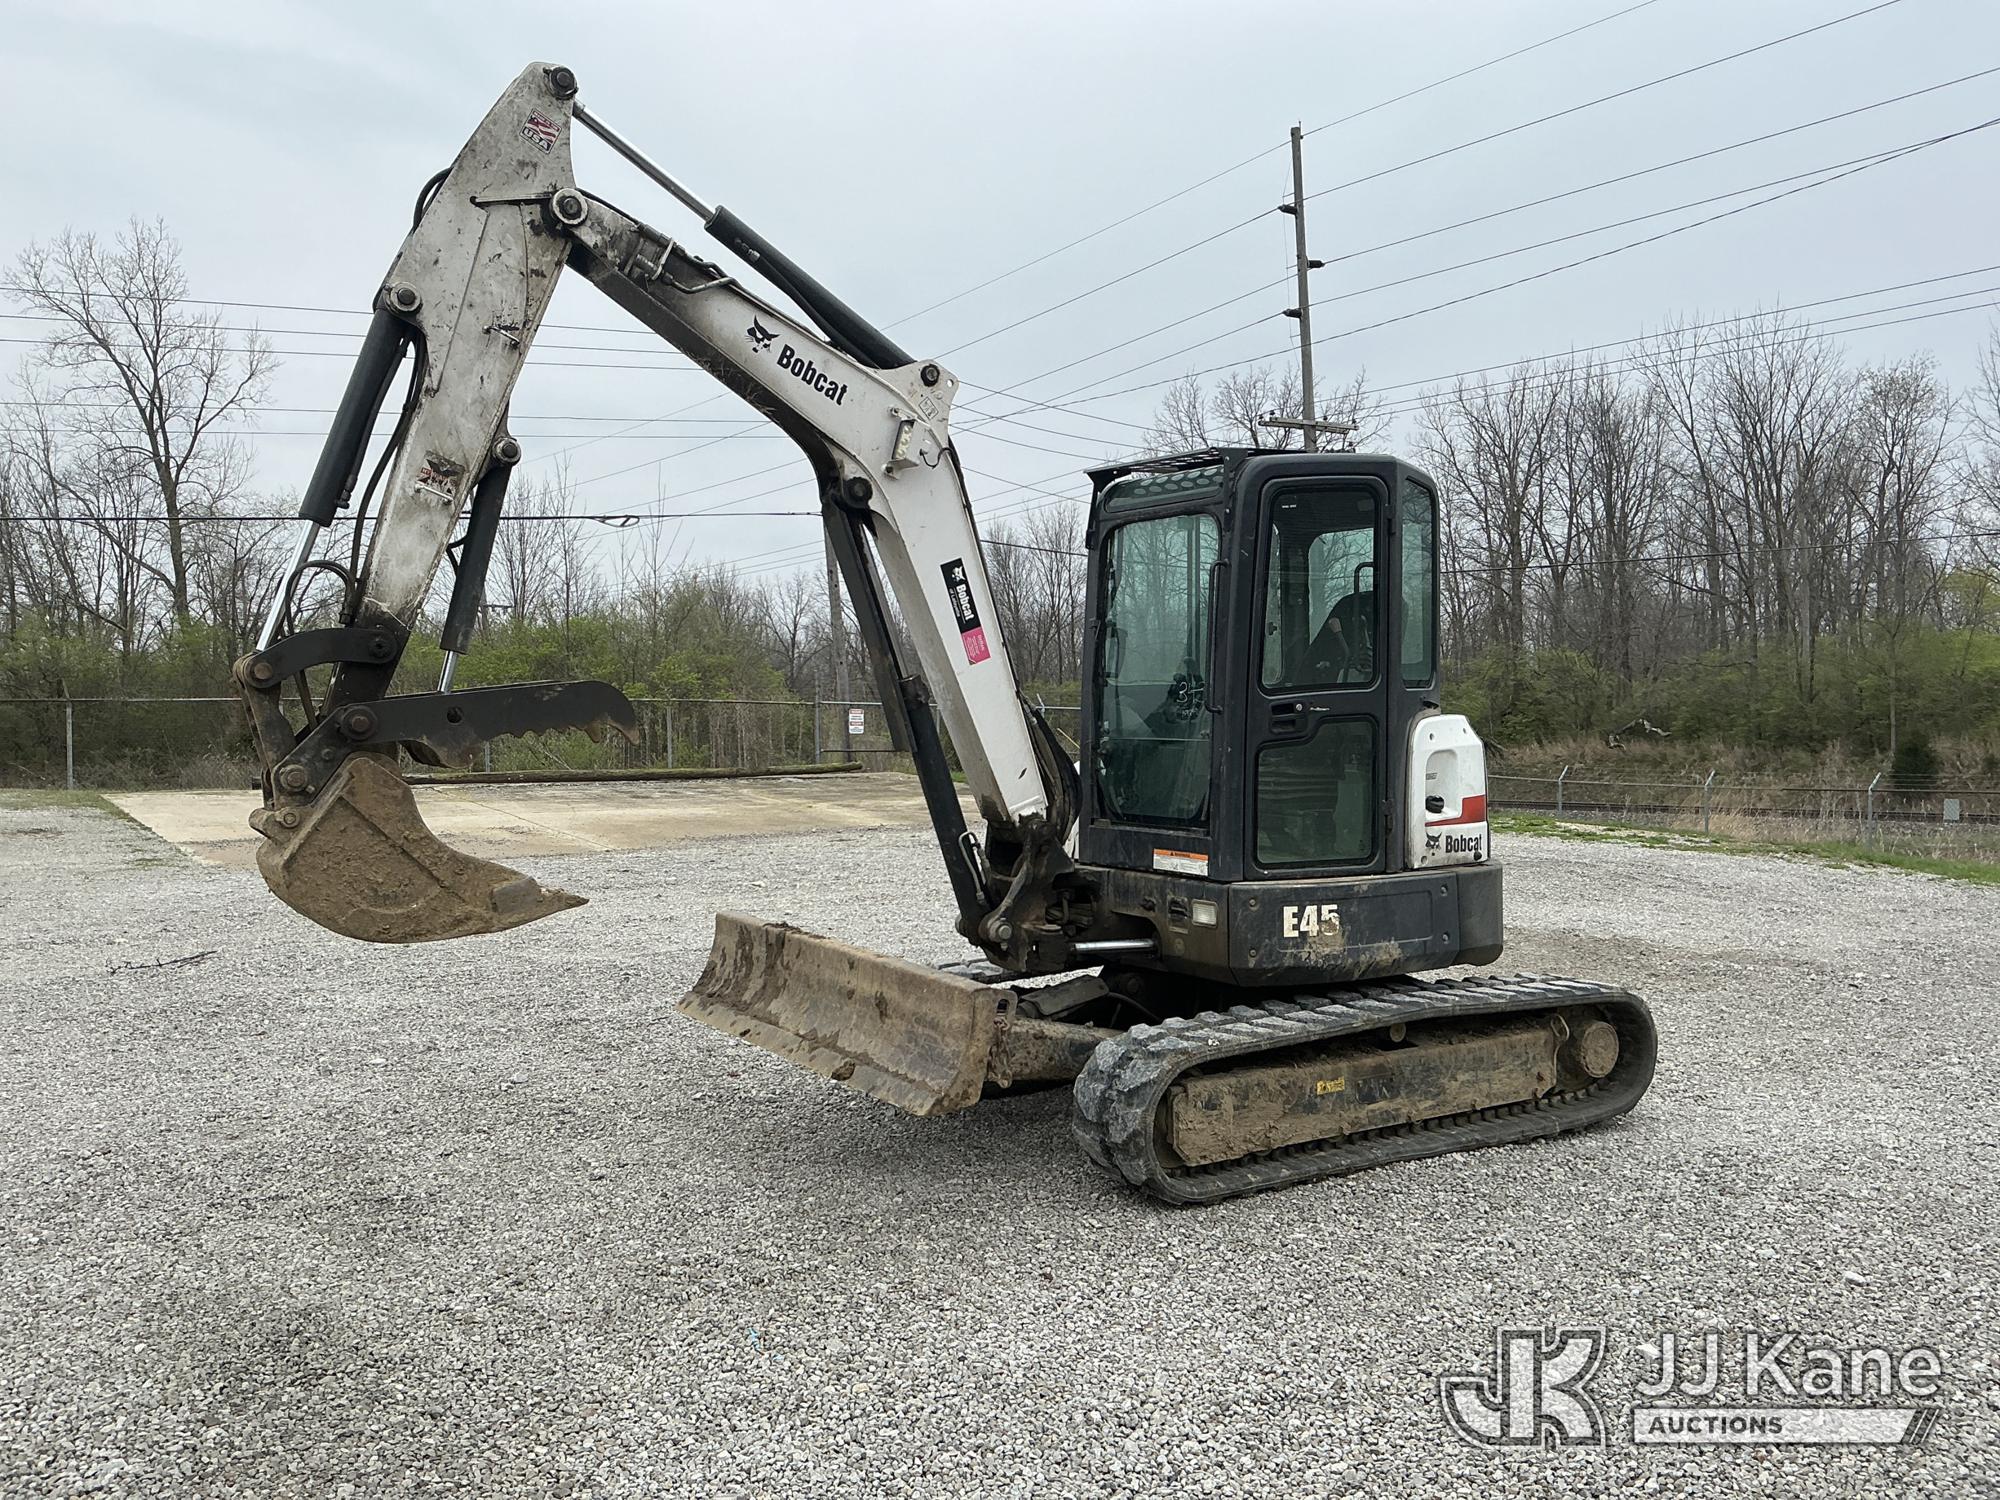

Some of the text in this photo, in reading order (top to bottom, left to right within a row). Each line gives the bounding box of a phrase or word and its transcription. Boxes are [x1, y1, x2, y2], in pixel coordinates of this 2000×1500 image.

[523, 127, 549, 150] USA
[776, 343, 848, 406] Bobcat
[956, 583, 975, 621] Bobcat
[1445, 833, 1482, 854] Bobcat
[1283, 904, 1340, 938] E45
